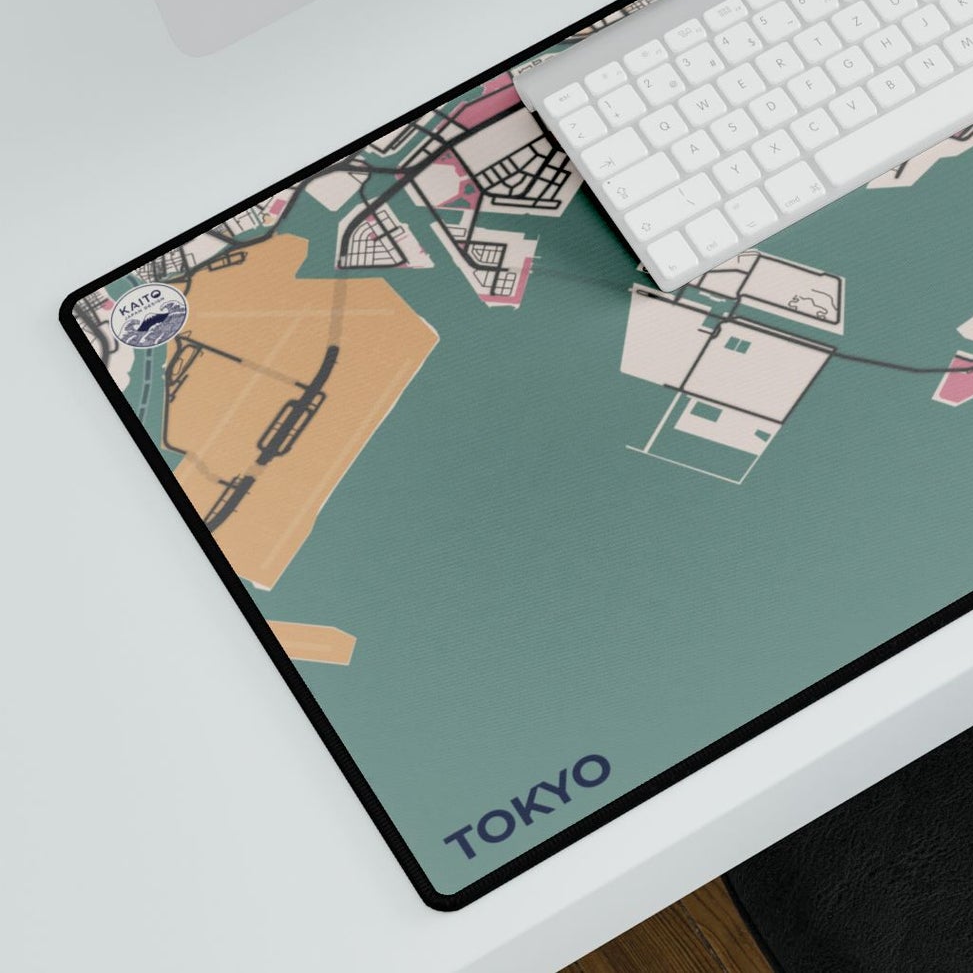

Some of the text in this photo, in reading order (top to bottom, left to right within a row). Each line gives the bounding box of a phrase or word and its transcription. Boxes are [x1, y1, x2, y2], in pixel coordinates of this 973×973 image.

[852, 16, 862, 27] Z
[880, 37, 892, 48] H
[960, 37, 973, 49] M
[775, 59, 786, 68] R
[923, 58, 935, 69] N
[885, 80, 896, 90] B
[696, 99, 709, 111] W
[766, 101, 776, 111] D
[846, 100, 856, 110] V
[659, 121, 671, 131] Q
[808, 121, 820, 131] C
[690, 144, 700, 154] A
[769, 143, 781, 154] X
[784, 195, 801, 208] cmd
[119, 289, 161, 316] KAITO
[442, 754, 611, 860] TOKYO
